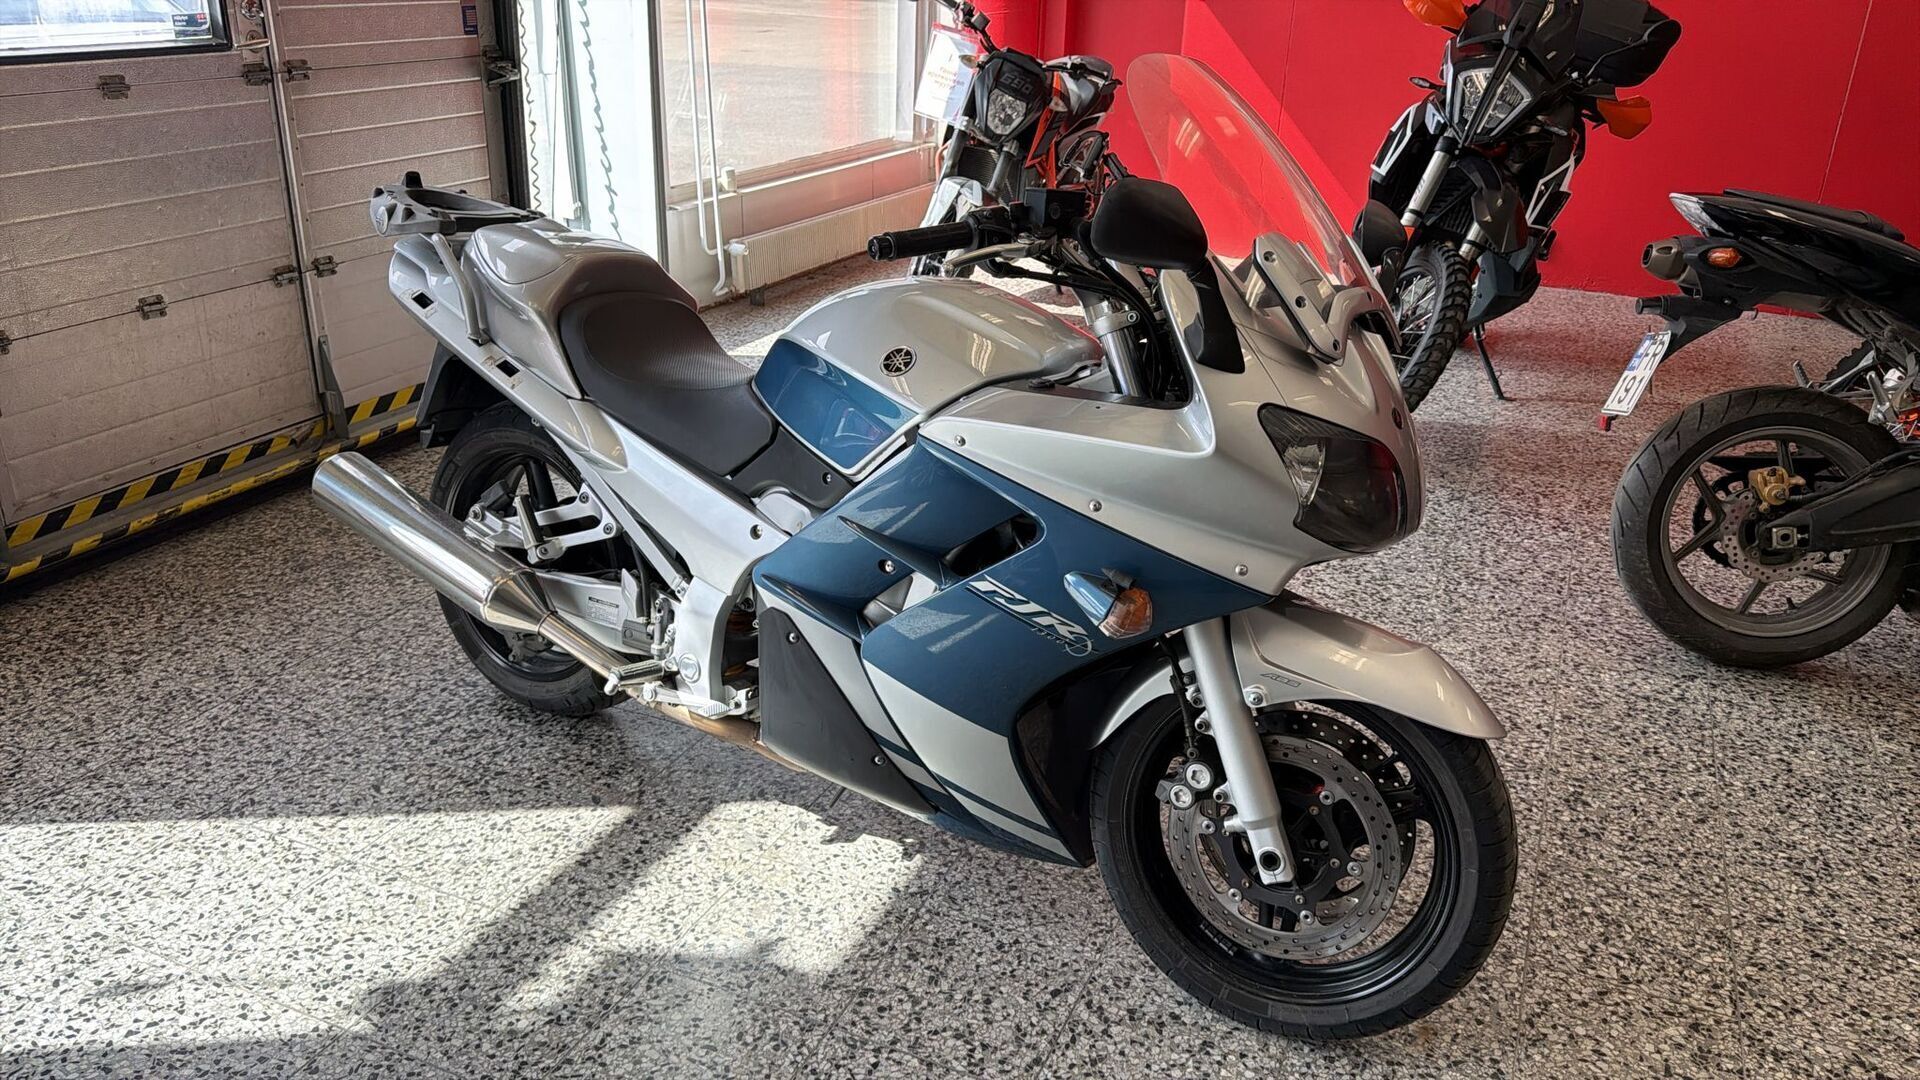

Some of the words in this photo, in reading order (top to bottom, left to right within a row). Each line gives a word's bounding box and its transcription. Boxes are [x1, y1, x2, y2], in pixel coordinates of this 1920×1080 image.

[1000, 73, 1033, 94] 690
[1636, 341, 1665, 371] FR
[1611, 375, 1645, 405] 191
[968, 573, 1088, 641] FJR
